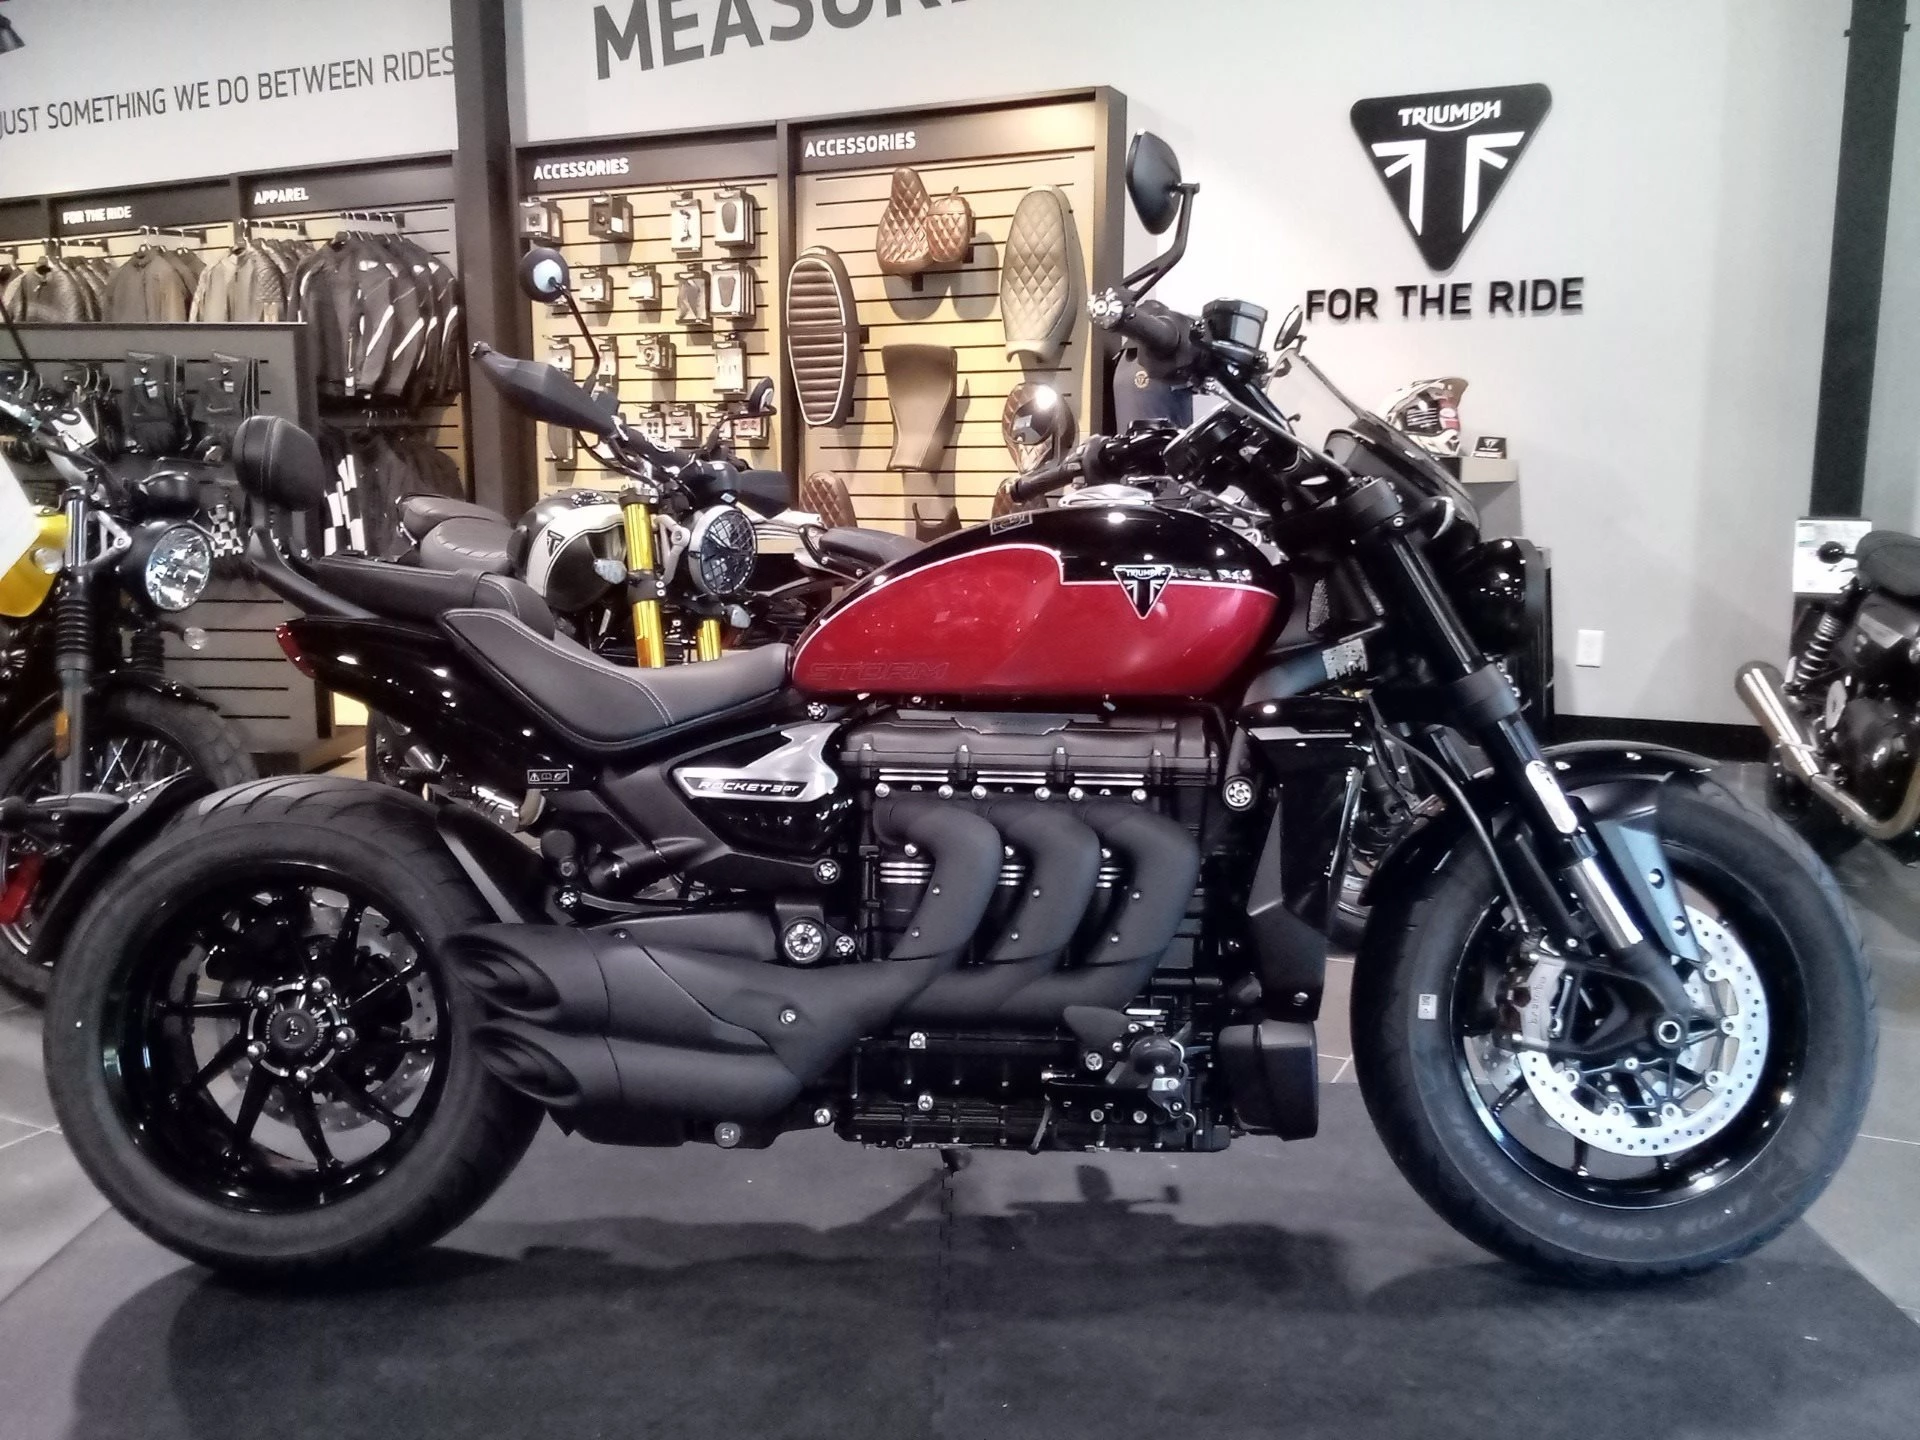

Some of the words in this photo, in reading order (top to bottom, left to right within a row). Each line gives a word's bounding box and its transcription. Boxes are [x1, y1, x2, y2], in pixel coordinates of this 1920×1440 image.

[46, 87, 166, 129] SOMETHING
[174, 81, 210, 111] WE
[217, 75, 249, 106] DO
[257, 57, 374, 100] BETWEEN
[383, 45, 455, 83] RIDES
[1398, 100, 1501, 132] TRIUMPH
[805, 131, 917, 158] ACCESSORIES
[533, 157, 630, 181] ACCESSORIES
[253, 187, 309, 205] APPAREL
[85, 208, 106, 222] THE
[106, 205, 132, 220] RIDE
[1305, 287, 1379, 321] FOR
[1395, 282, 1473, 320] THE
[1489, 276, 1585, 317] RIDE
[809, 662, 949, 681] STORM
